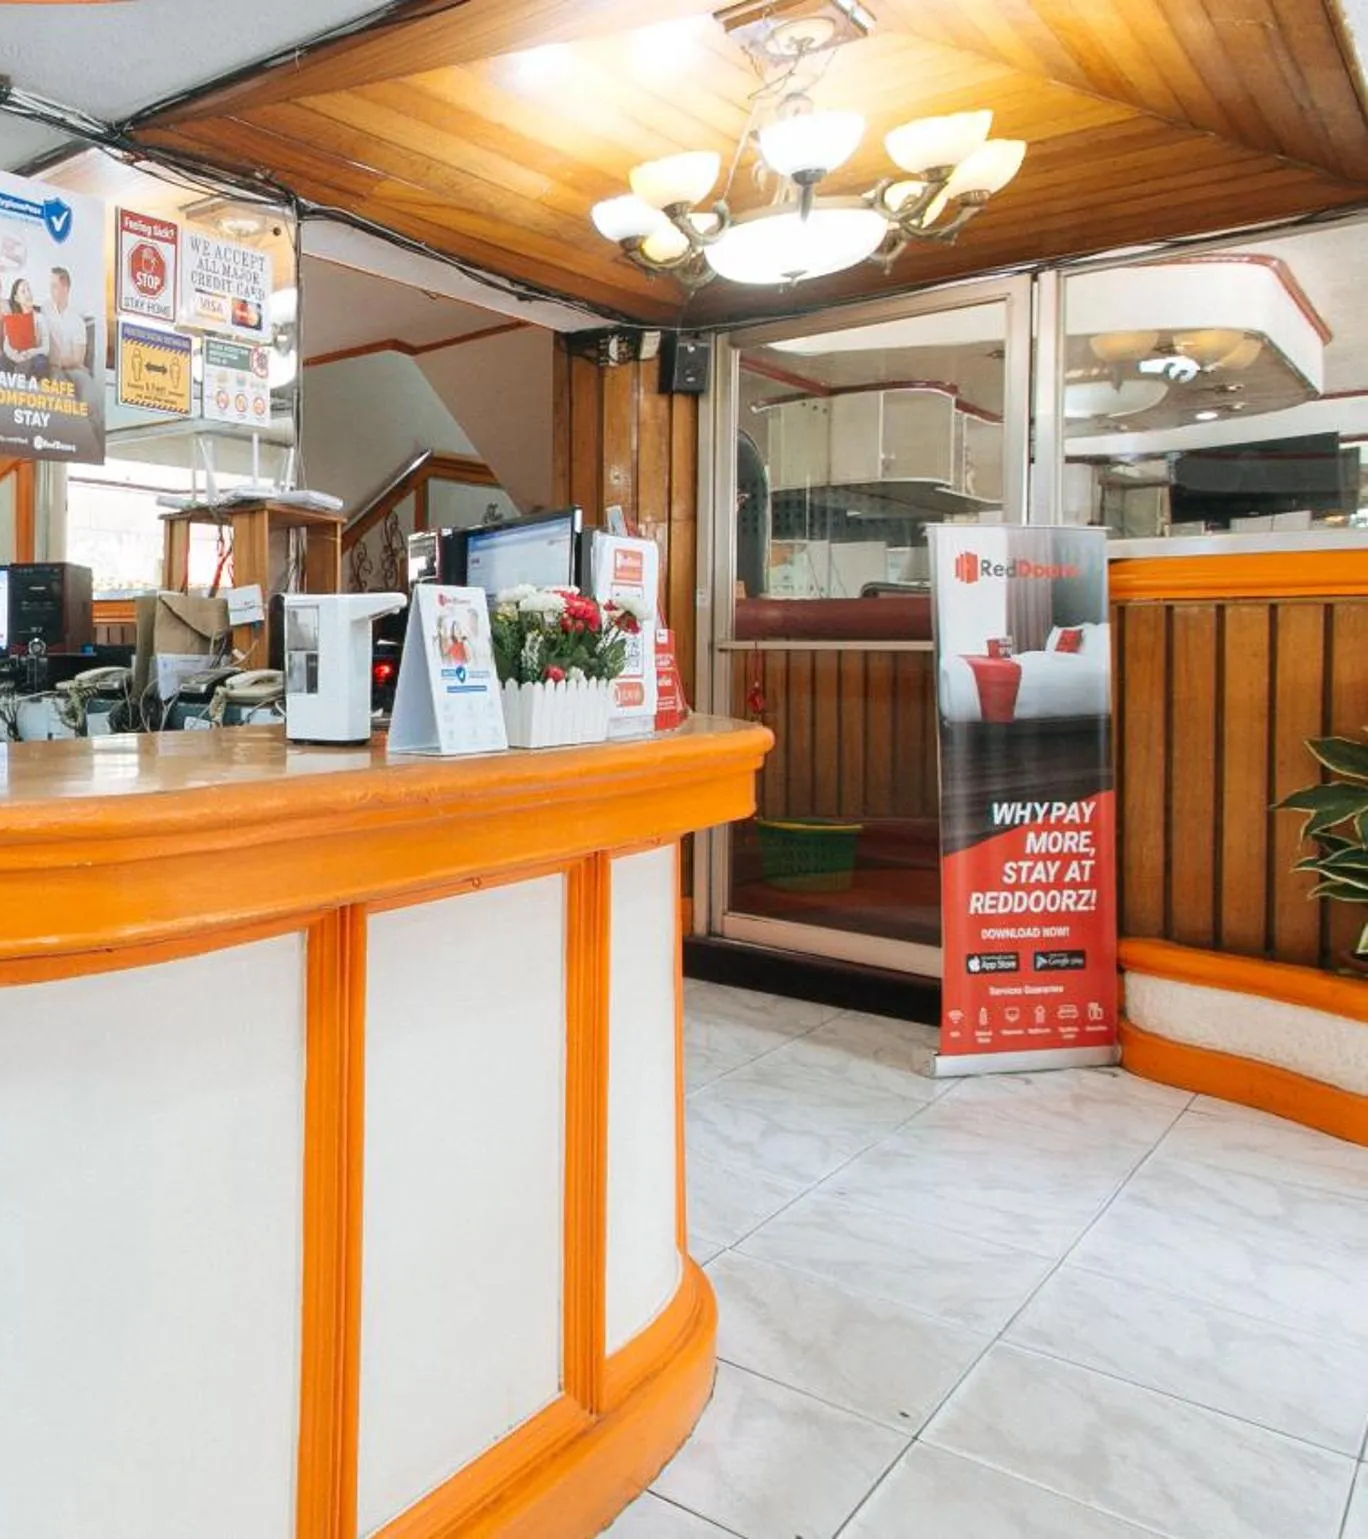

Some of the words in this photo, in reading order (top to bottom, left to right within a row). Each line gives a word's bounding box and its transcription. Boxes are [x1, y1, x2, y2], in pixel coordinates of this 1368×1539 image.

[190, 235, 210, 256] WE
[214, 245, 264, 272] ACCEPT
[136, 271, 161, 290] STOP
[191, 270, 232, 293] CREDIT
[197, 256, 220, 273] ALL
[222, 263, 260, 284] MAJOR
[199, 297, 224, 313] VISA
[28, 377, 39, 391] A
[40, 377, 75, 397] SAFE
[14, 409, 52, 427] STAY
[992, 801, 1049, 825] WHY
[1050, 801, 1096, 825] PAY
[1025, 831, 1096, 856] MORE,
[1002, 861, 1060, 884] STAY
[1064, 860, 1095, 882] AT
[969, 889, 1097, 914] REDDOORZ!
[981, 927, 1040, 940] DOWNLOAD
[1042, 926, 1070, 938] NOW!
